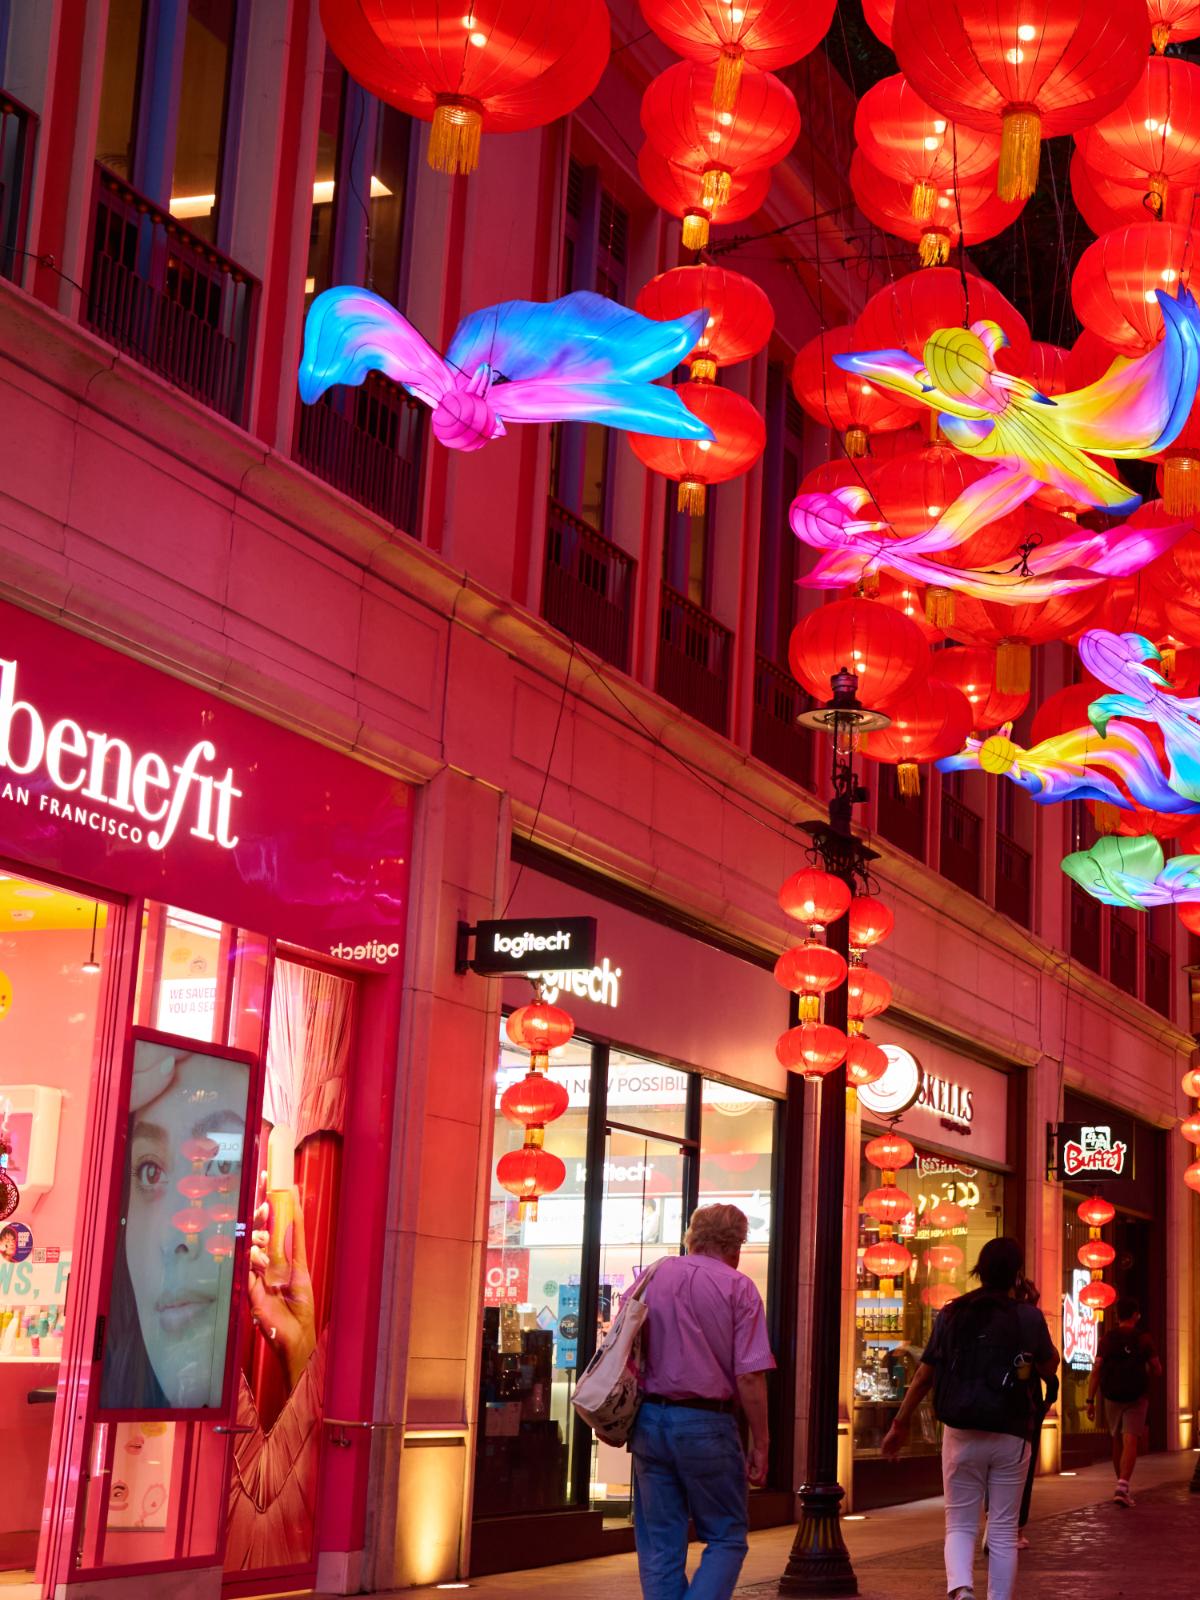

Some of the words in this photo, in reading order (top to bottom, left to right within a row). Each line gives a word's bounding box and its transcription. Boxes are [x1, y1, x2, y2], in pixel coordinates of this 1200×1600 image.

[0, 659, 242, 850] benefit
[39, 794, 142, 844] FRANCISCO
[494, 930, 571, 958] logitech
[197, 1000, 215, 1013] SEA
